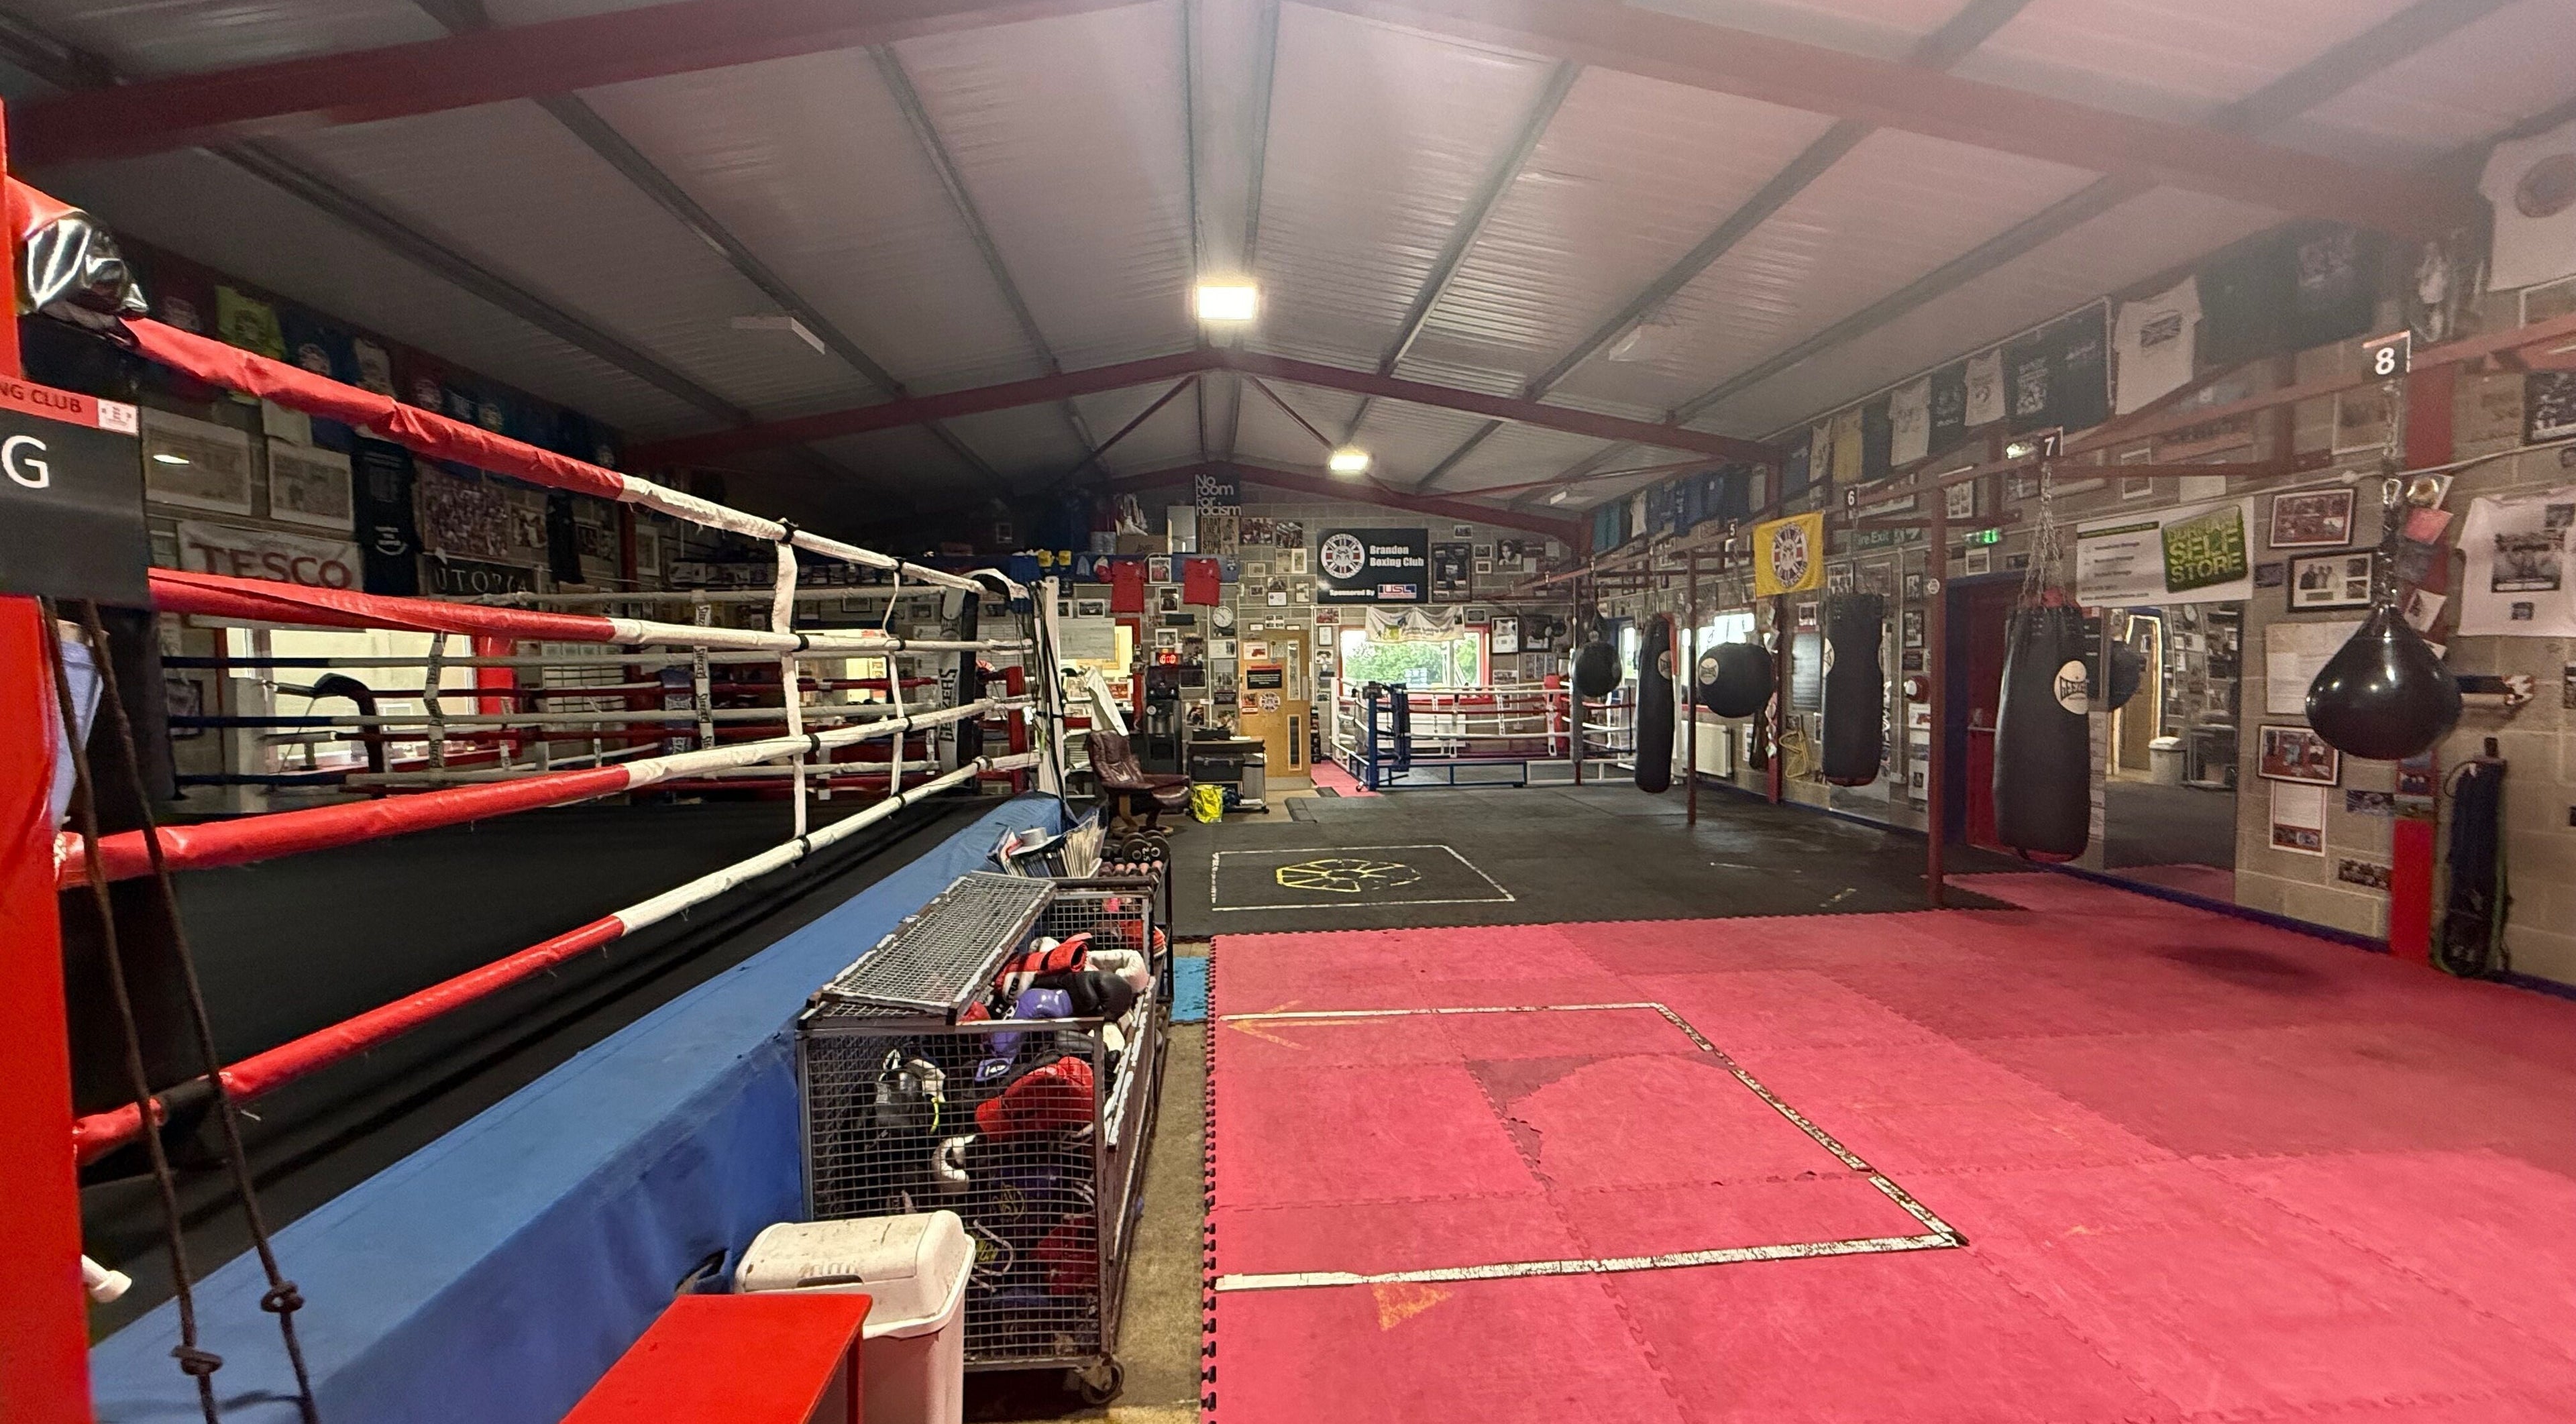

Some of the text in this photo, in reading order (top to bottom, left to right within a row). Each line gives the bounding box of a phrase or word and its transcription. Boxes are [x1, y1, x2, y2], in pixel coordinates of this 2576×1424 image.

[2375, 347, 2395, 375] 8
[31, 390, 82, 413] CLUB
[2044, 436, 2055, 457] 7
[1, 435, 50, 489] G
[1195, 474, 1216, 486] No
[1196, 484, 1234, 495] room
[1196, 496, 1216, 507] for
[1847, 490, 1855, 506] 6
[1196, 503, 1242, 516] racism
[1730, 523, 1735, 536] 5
[1369, 545, 1409, 555] Brandon
[2169, 528, 2239, 565] SELF
[188, 541, 353, 589] TESCO
[1369, 557, 1424, 567] Boxing Club
[2171, 551, 2242, 583] STORE
[1366, 589, 1375, 597] By
[938, 668, 959, 743] GEZERS
